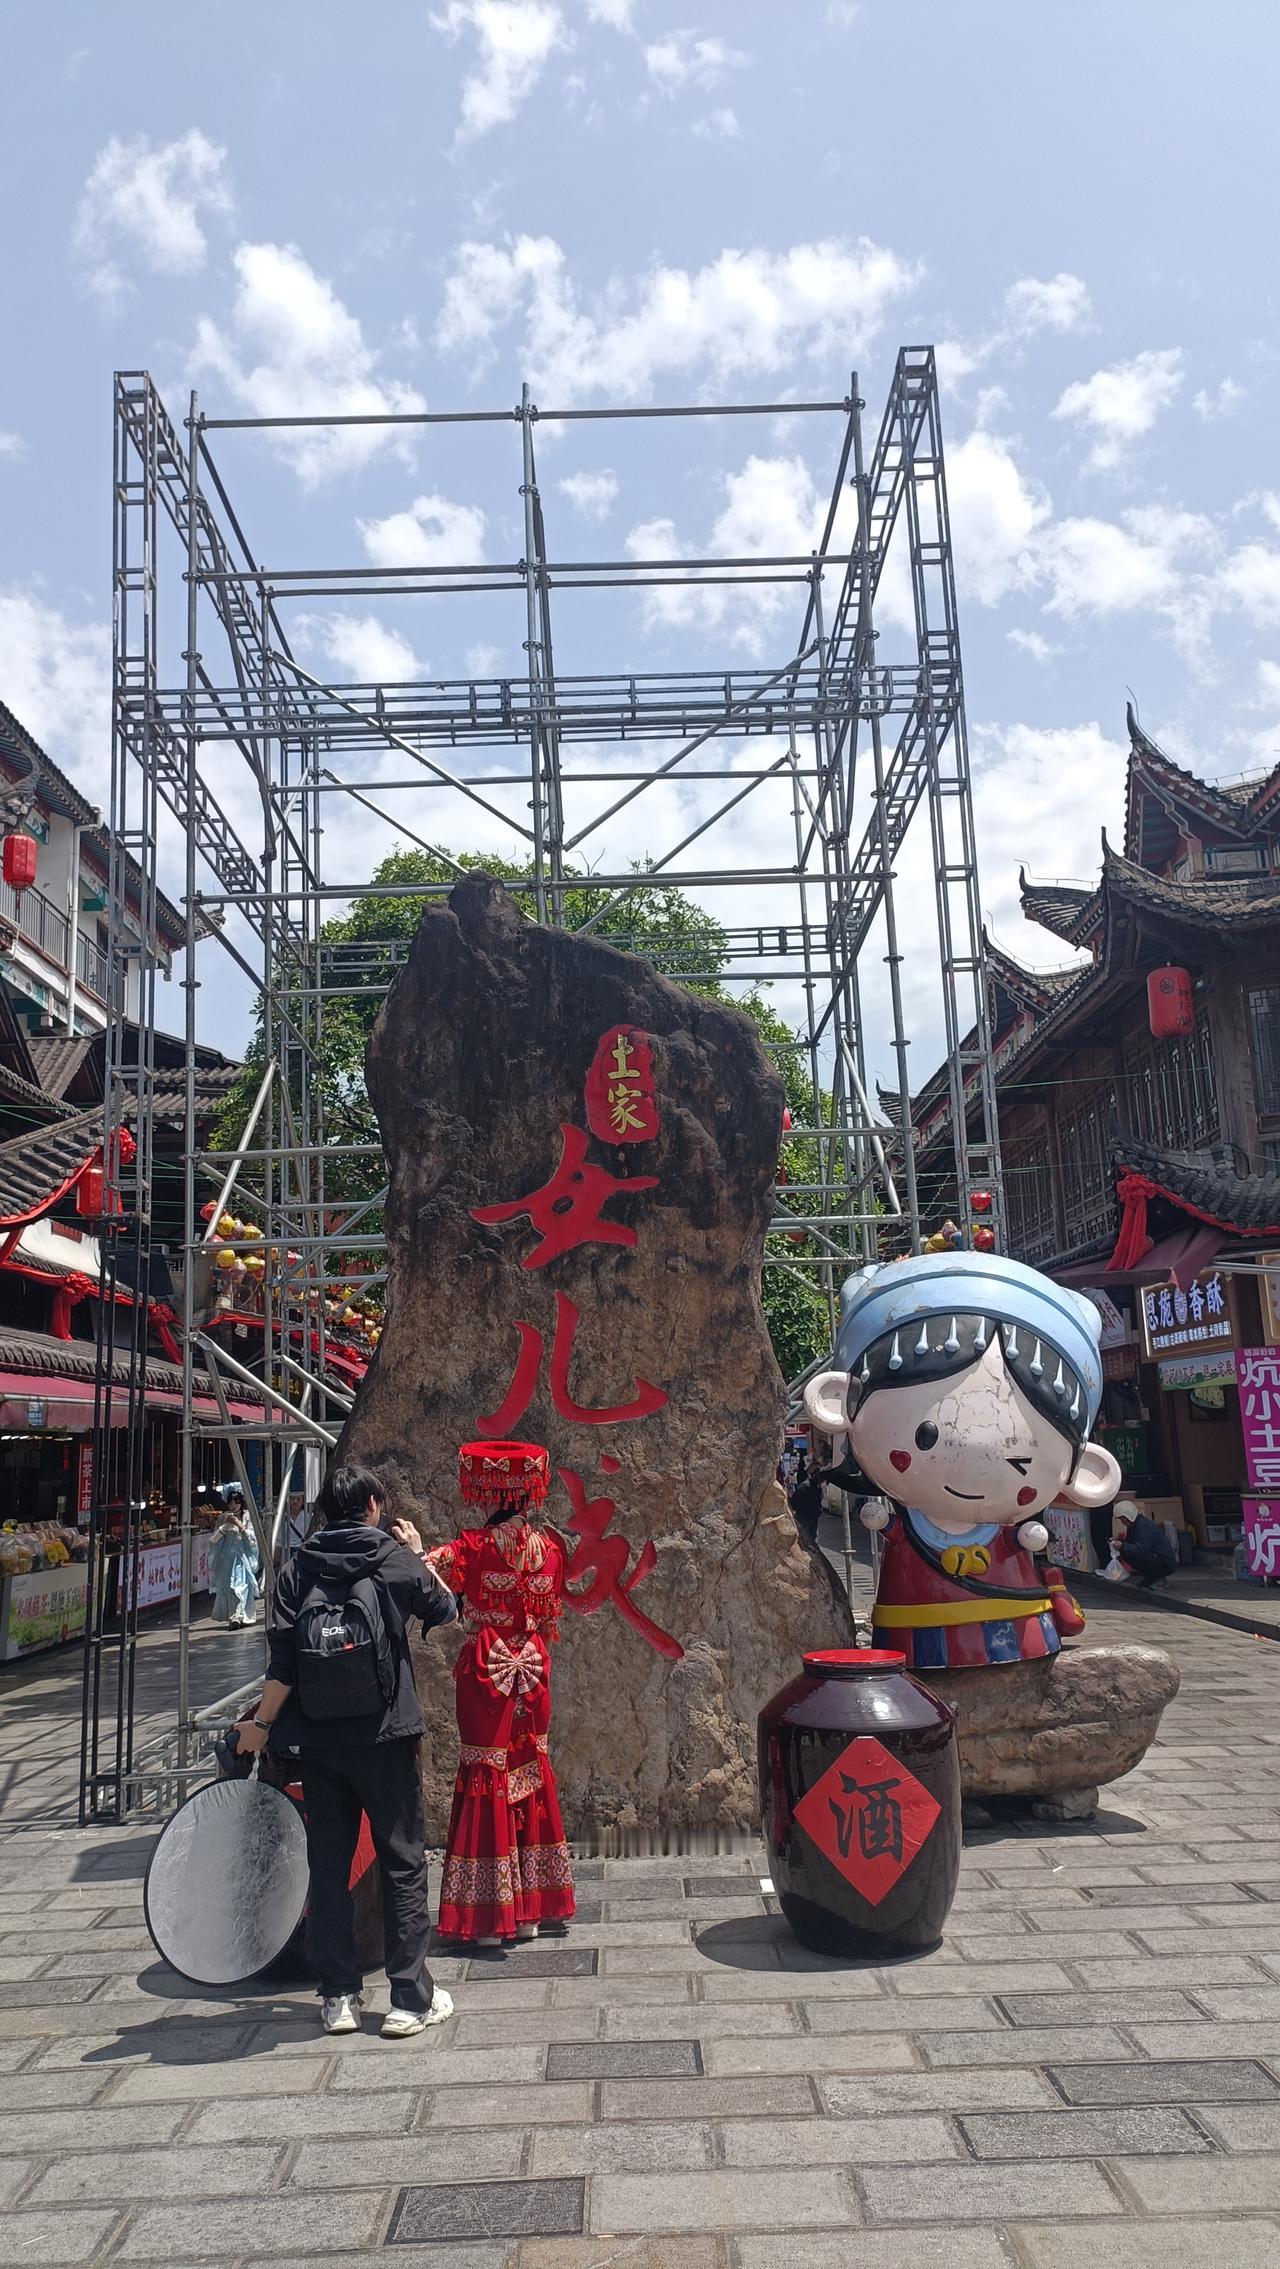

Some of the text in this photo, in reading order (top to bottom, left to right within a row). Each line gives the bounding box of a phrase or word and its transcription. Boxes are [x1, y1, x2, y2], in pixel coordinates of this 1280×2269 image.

[606, 1033, 648, 1135] 土家
[1146, 1288, 1175, 1331] 恩施
[1189, 1272, 1224, 1321] 香酥
[82, 1448, 93, 1510] 新茶上市
[322, 1626, 345, 1637] EOS
[829, 1771, 903, 1862] 酒
